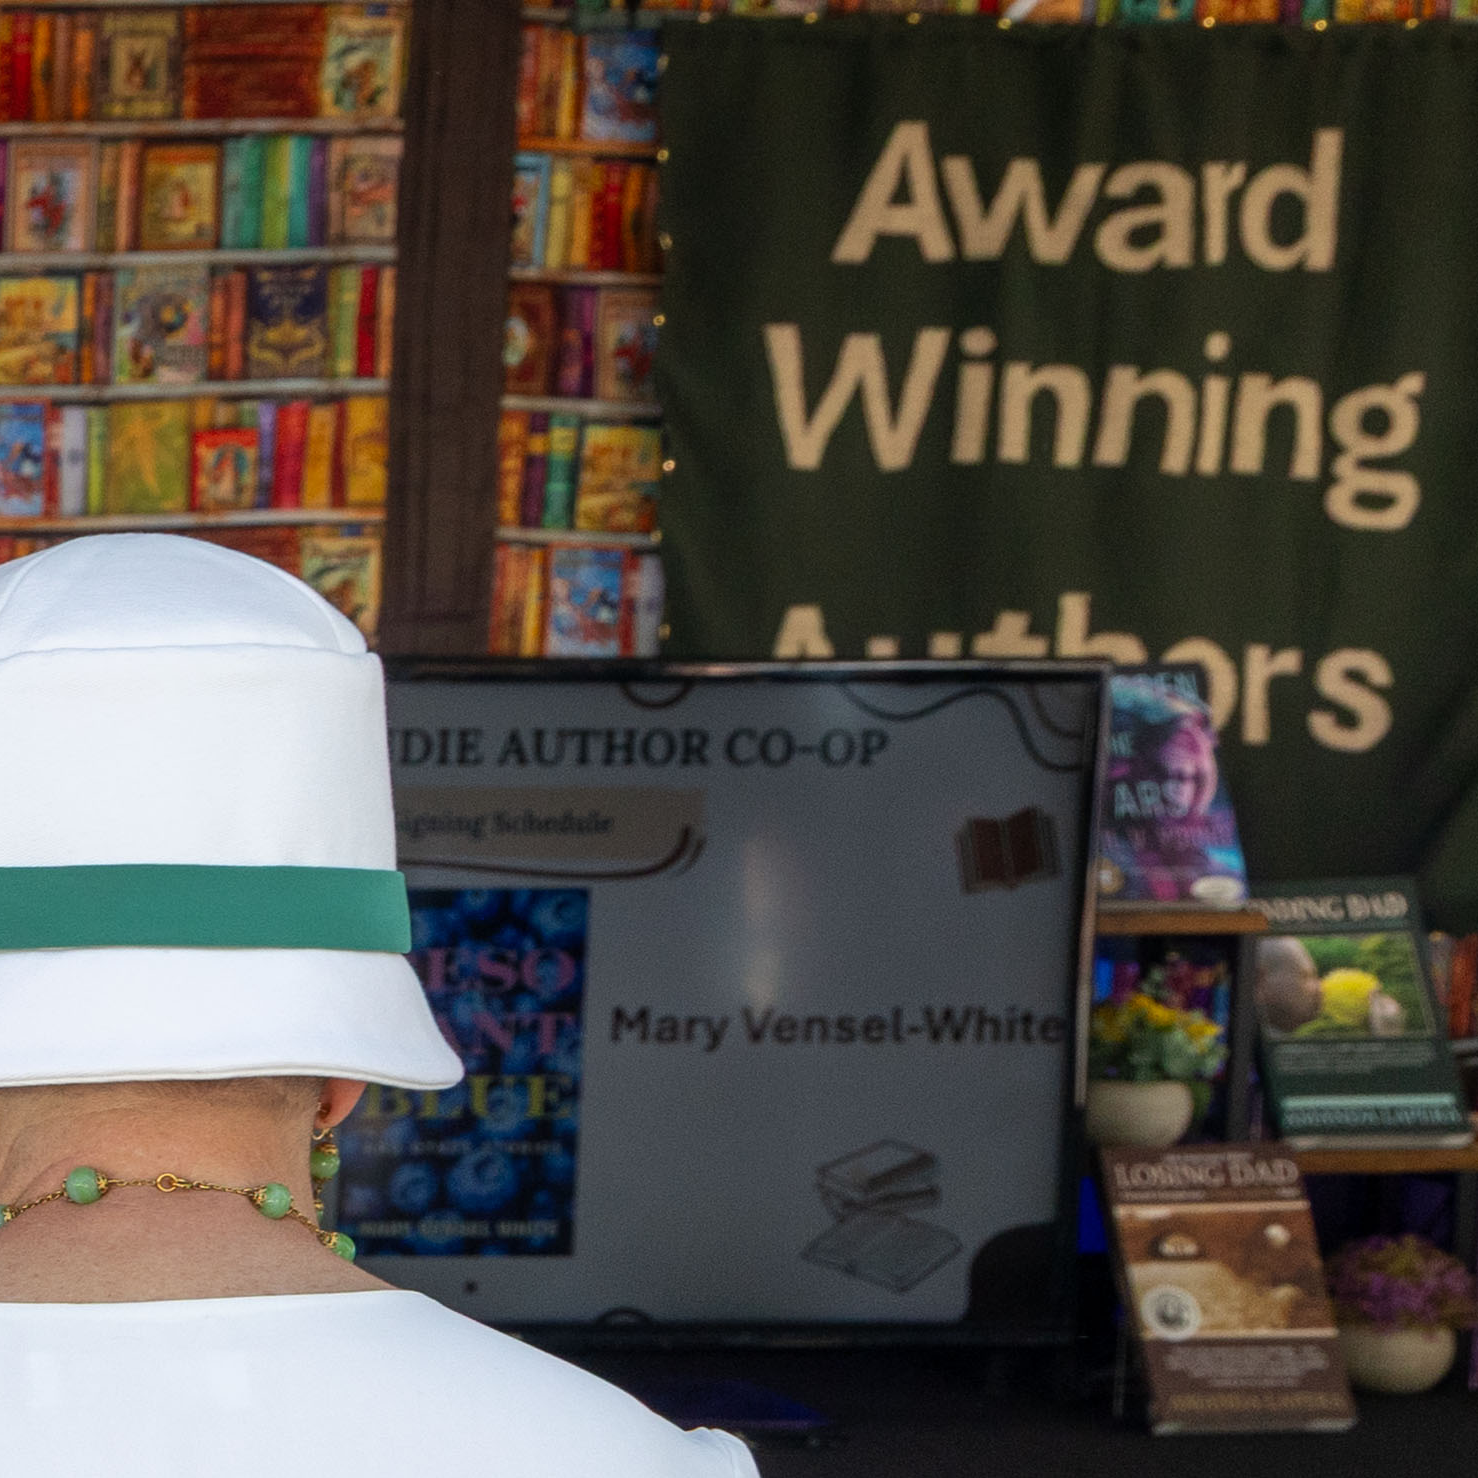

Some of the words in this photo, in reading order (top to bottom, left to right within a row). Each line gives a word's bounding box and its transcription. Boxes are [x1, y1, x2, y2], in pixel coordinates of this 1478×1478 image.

[832, 119, 1344, 272] Award
[763, 323, 1428, 531] Winning
[391, 727, 485, 767] DIE
[497, 728, 712, 767] AUTHOR
[724, 727, 890, 766] CO-OP
[610, 1006, 729, 1052] Mary
[743, 1005, 1067, 1046] Vensel-White
[362, 1073, 576, 1121] BLUE
[1226, 1157, 1299, 1186] DAD
